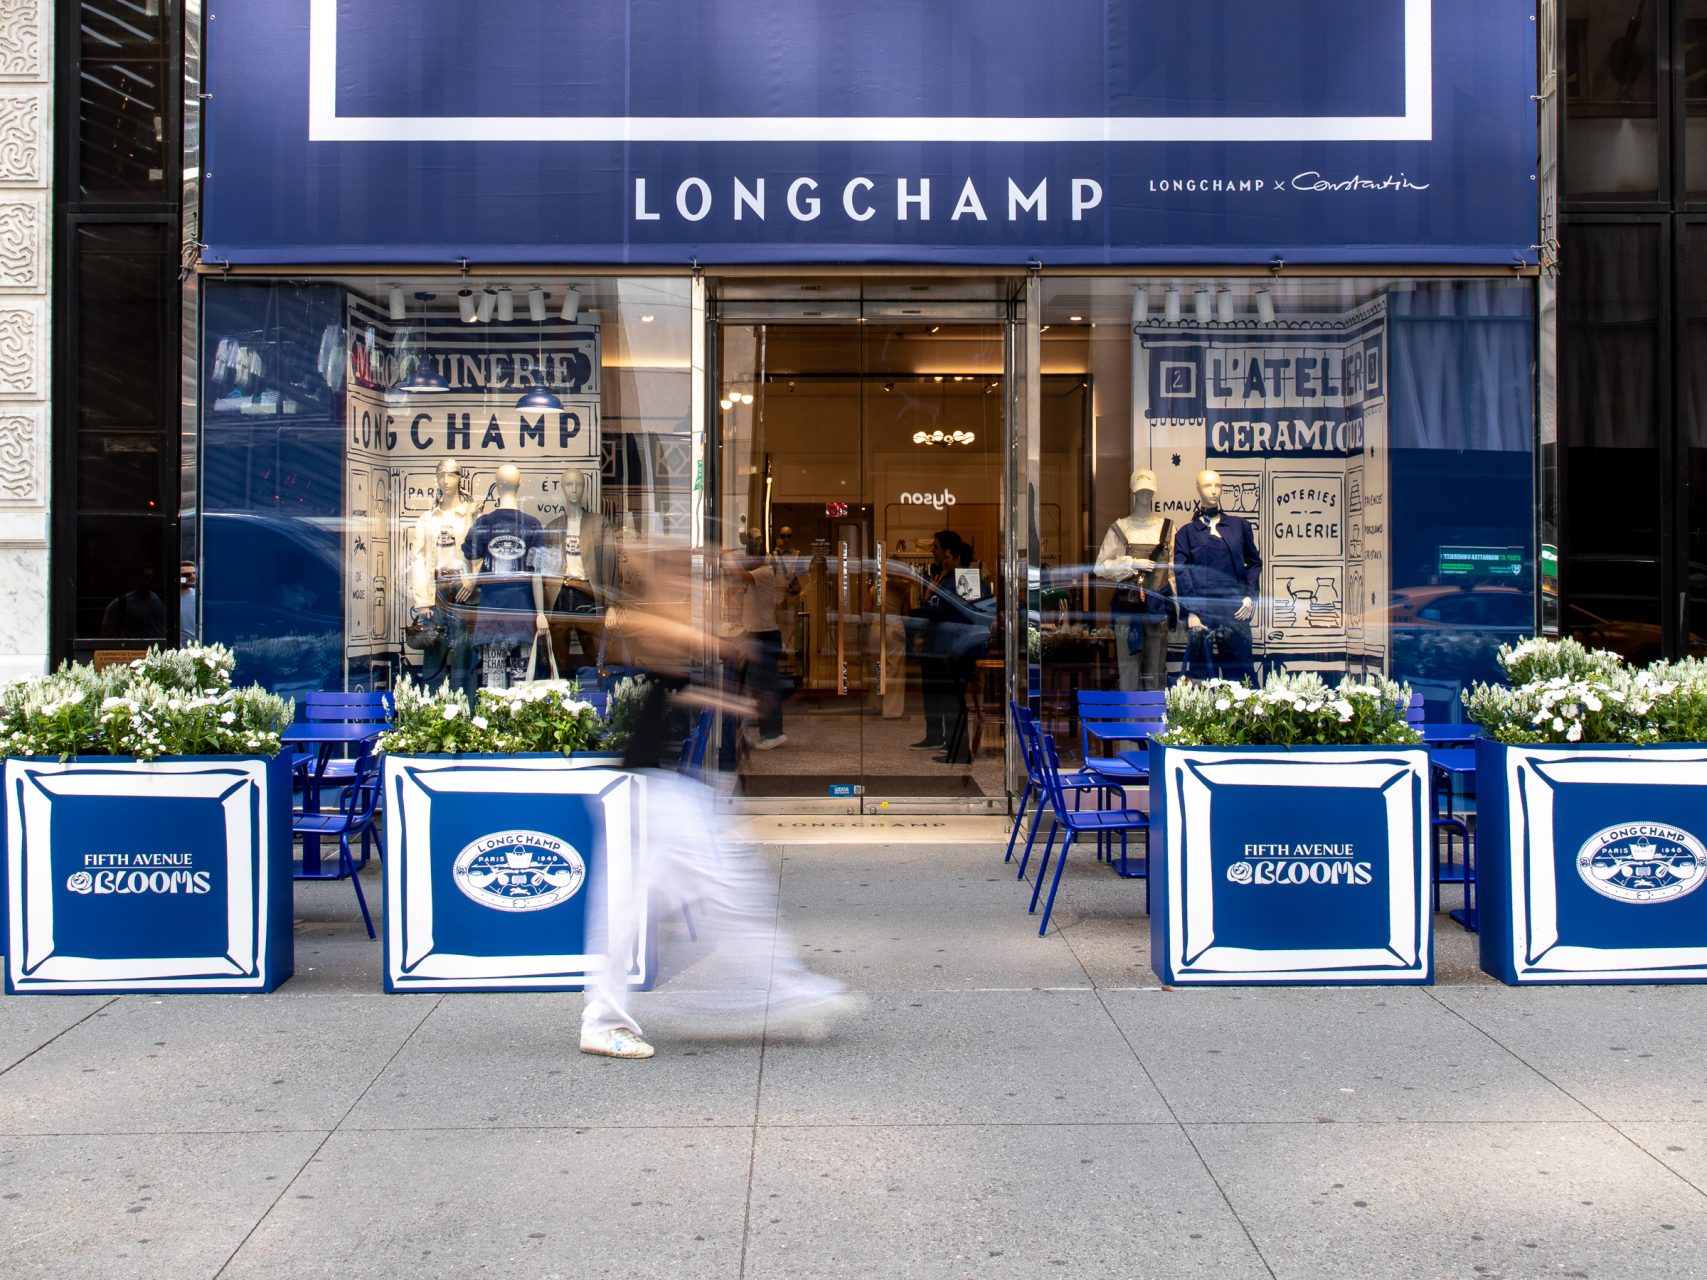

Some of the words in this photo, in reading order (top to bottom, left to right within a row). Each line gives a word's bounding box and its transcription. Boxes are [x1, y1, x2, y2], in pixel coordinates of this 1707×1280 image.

[1149, 179, 1265, 192] LONGCHAMP
[1291, 170, 1431, 192] Constantin
[634, 176, 1105, 222] LONGCHAMP
[1172, 369, 1183, 388] 2
[1212, 351, 1364, 399] L'ATELIER
[352, 405, 581, 451] LONGCHAMP
[1211, 418, 1364, 455] CERAMIQUE
[1276, 488, 1337, 508] POTERIES
[1274, 522, 1339, 539] GALERIE
[477, 834, 561, 853] LONGCHAMP
[1600, 826, 1685, 845] LONGCHAMP
[84, 853, 129, 866] FIFTH
[132, 853, 193, 866] AVENUE
[1244, 843, 1289, 856] FIFTH
[1293, 843, 1354, 856] AVENUE
[94, 870, 212, 895] BLOOMS
[1254, 860, 1373, 885] BLOOMS
